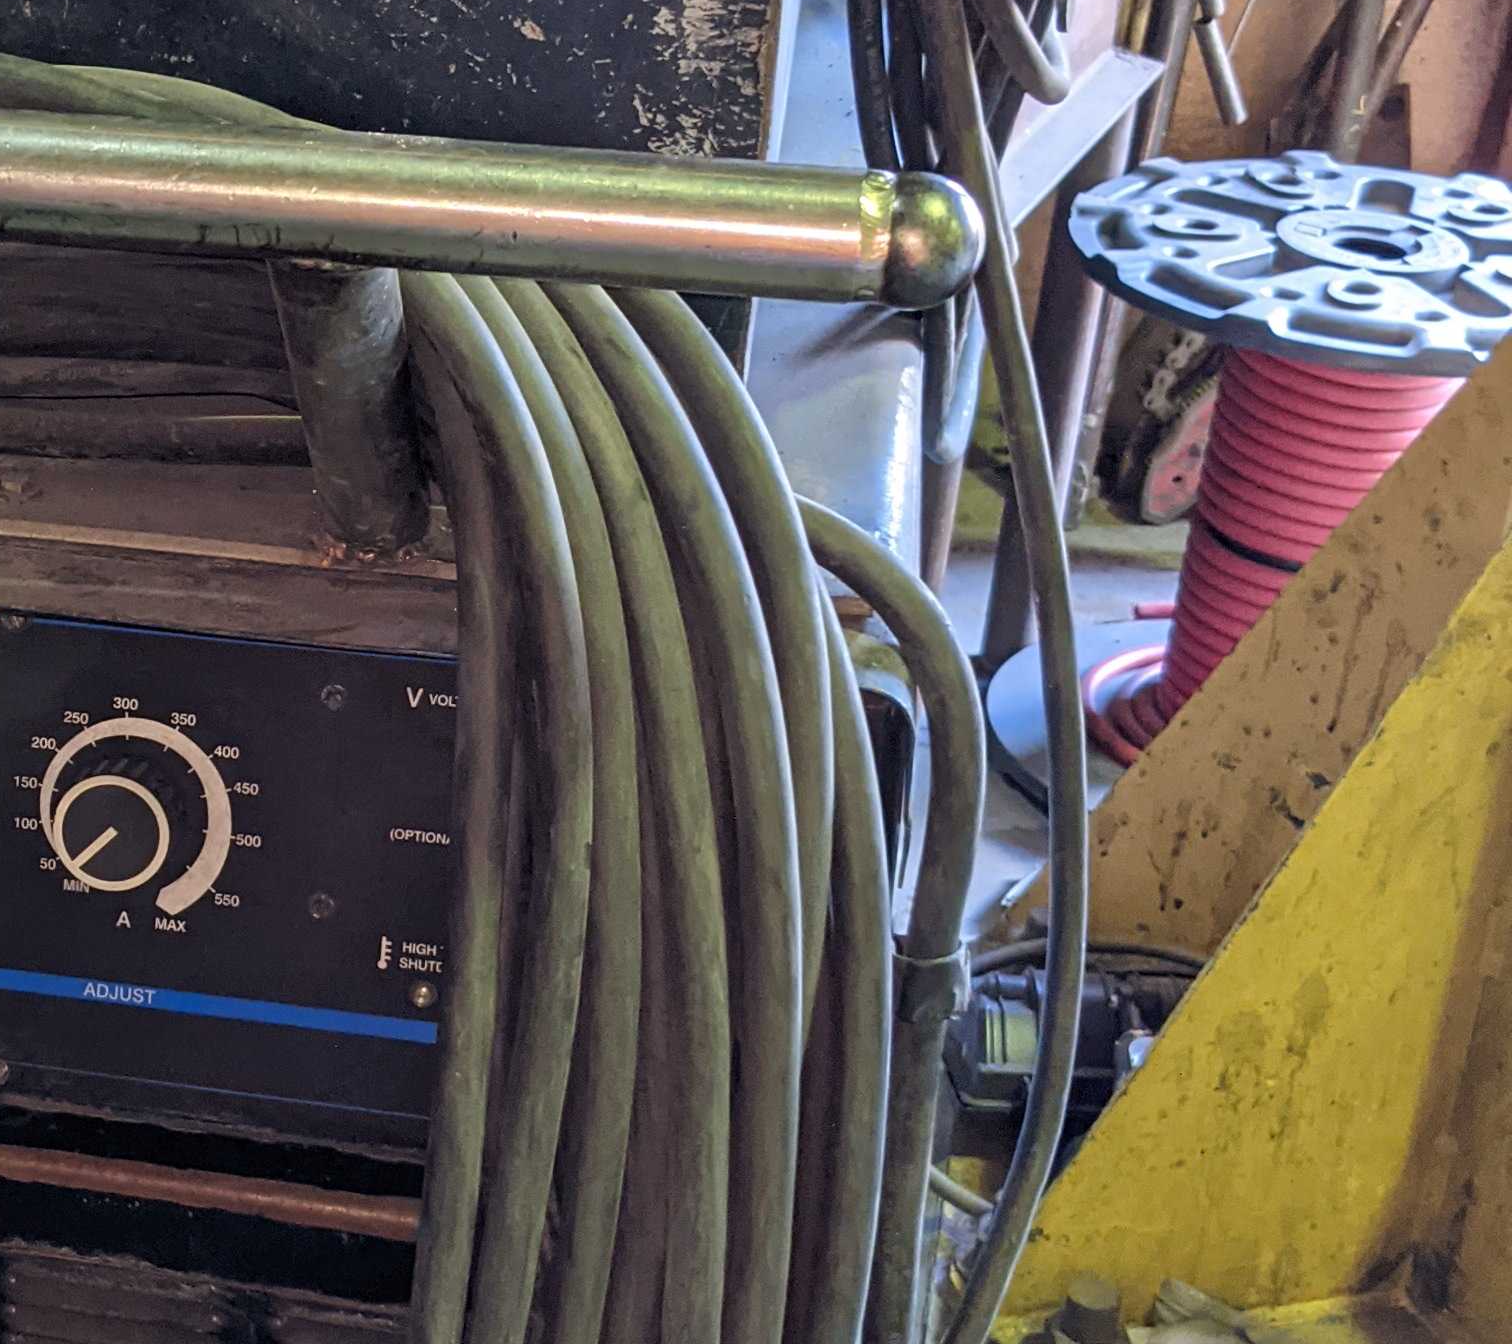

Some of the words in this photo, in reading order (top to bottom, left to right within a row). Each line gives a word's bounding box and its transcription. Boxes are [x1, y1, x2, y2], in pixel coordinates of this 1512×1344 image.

[113, 697, 138, 711] 300
[406, 687, 424, 708] V
[429, 694, 458, 707] VOL
[64, 712, 88, 725] 250
[171, 713, 196, 727] 350
[32, 737, 56, 750] 200
[214, 746, 239, 759] 400
[14, 776, 37, 789] 150
[233, 782, 259, 796] 450
[14, 818, 38, 831] 100
[235, 834, 261, 848] 500
[390, 827, 450, 845] (OPTION
[39, 858, 56, 870] 50
[63, 879, 89, 893] MIN
[214, 893, 239, 907] 550
[116, 911, 131, 928] A
[154, 918, 186, 933] MAX
[402, 942, 436, 956] HIGH
[83, 982, 156, 1005] ADJUST
